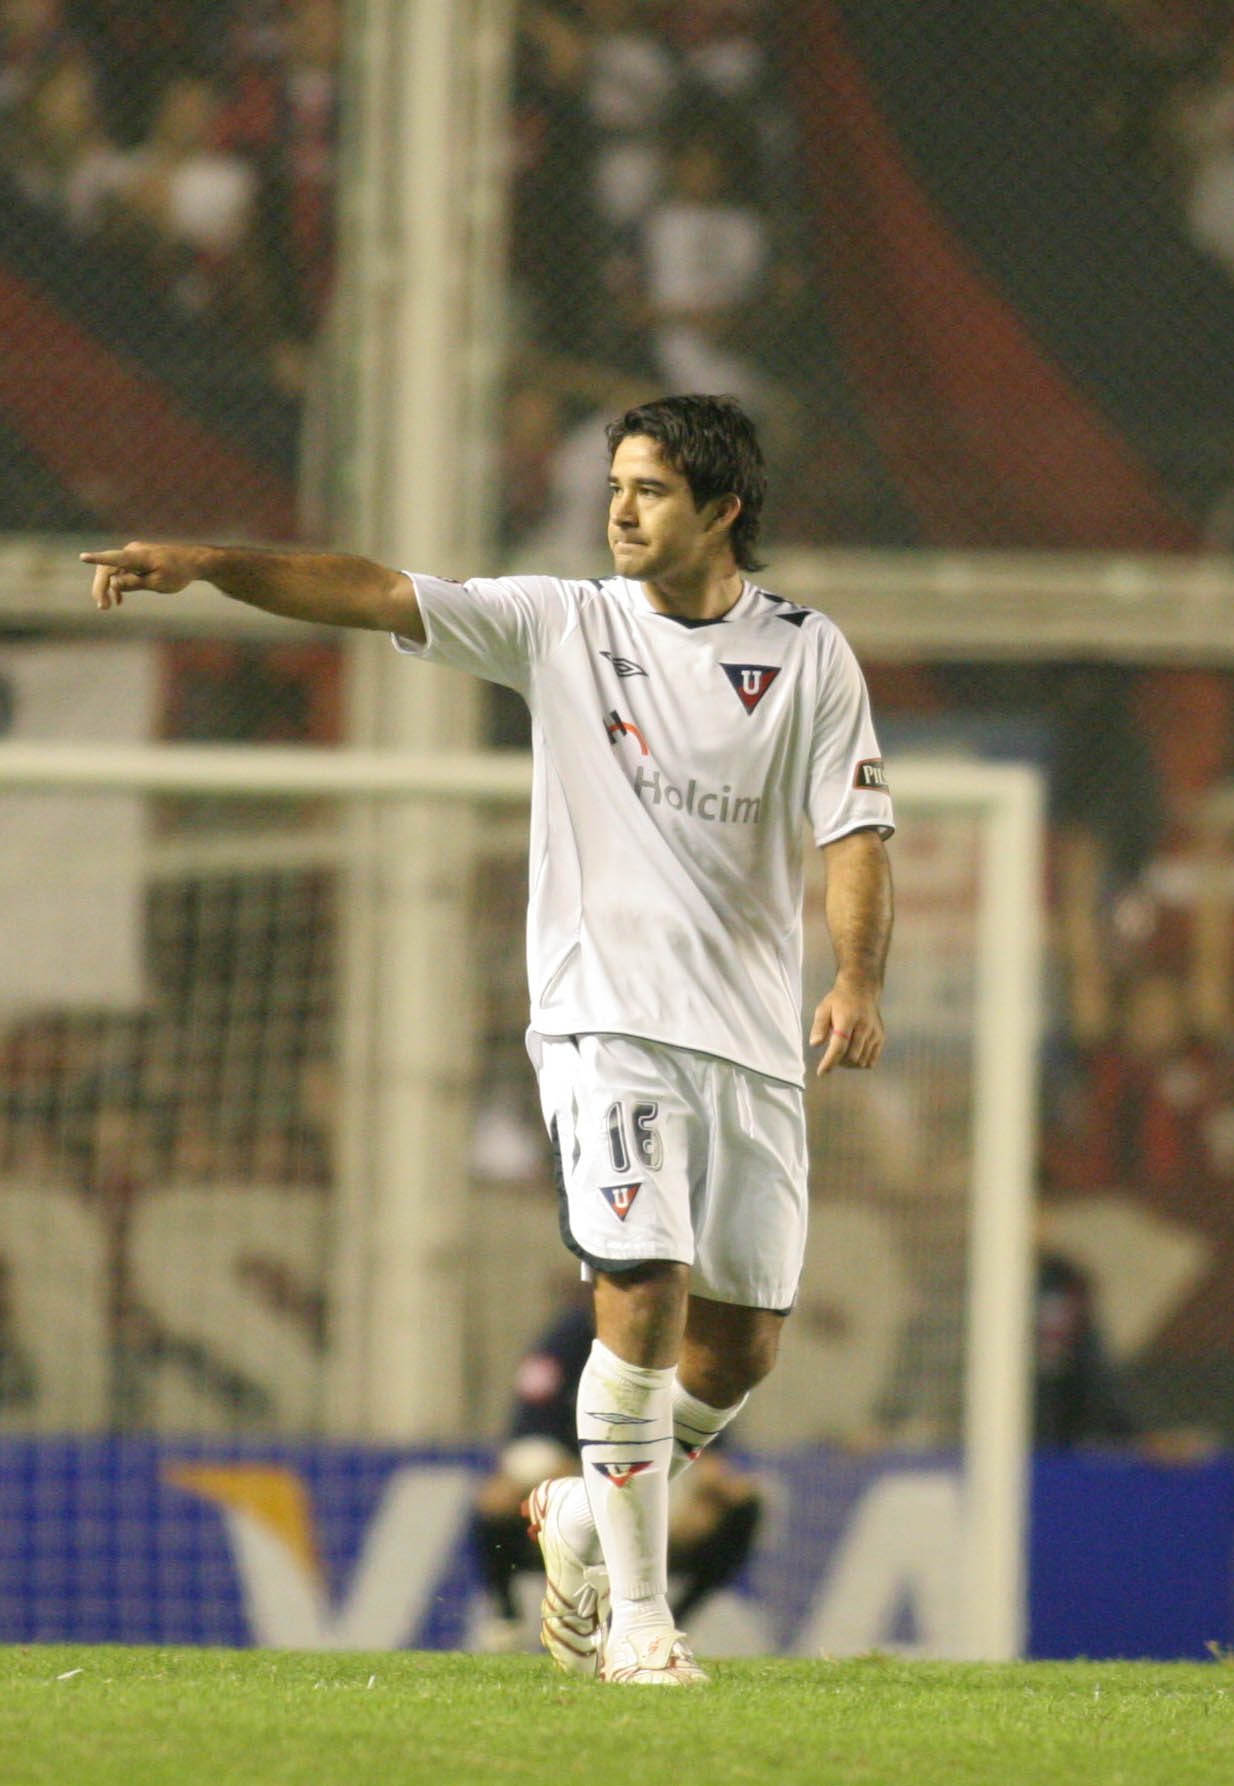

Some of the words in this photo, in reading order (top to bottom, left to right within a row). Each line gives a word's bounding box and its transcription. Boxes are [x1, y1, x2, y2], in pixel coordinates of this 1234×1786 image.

[741, 670, 763, 695] U
[634, 766, 761, 823] Holcim
[612, 1188, 630, 1208] U
[160, 1462, 1025, 1656] VA
